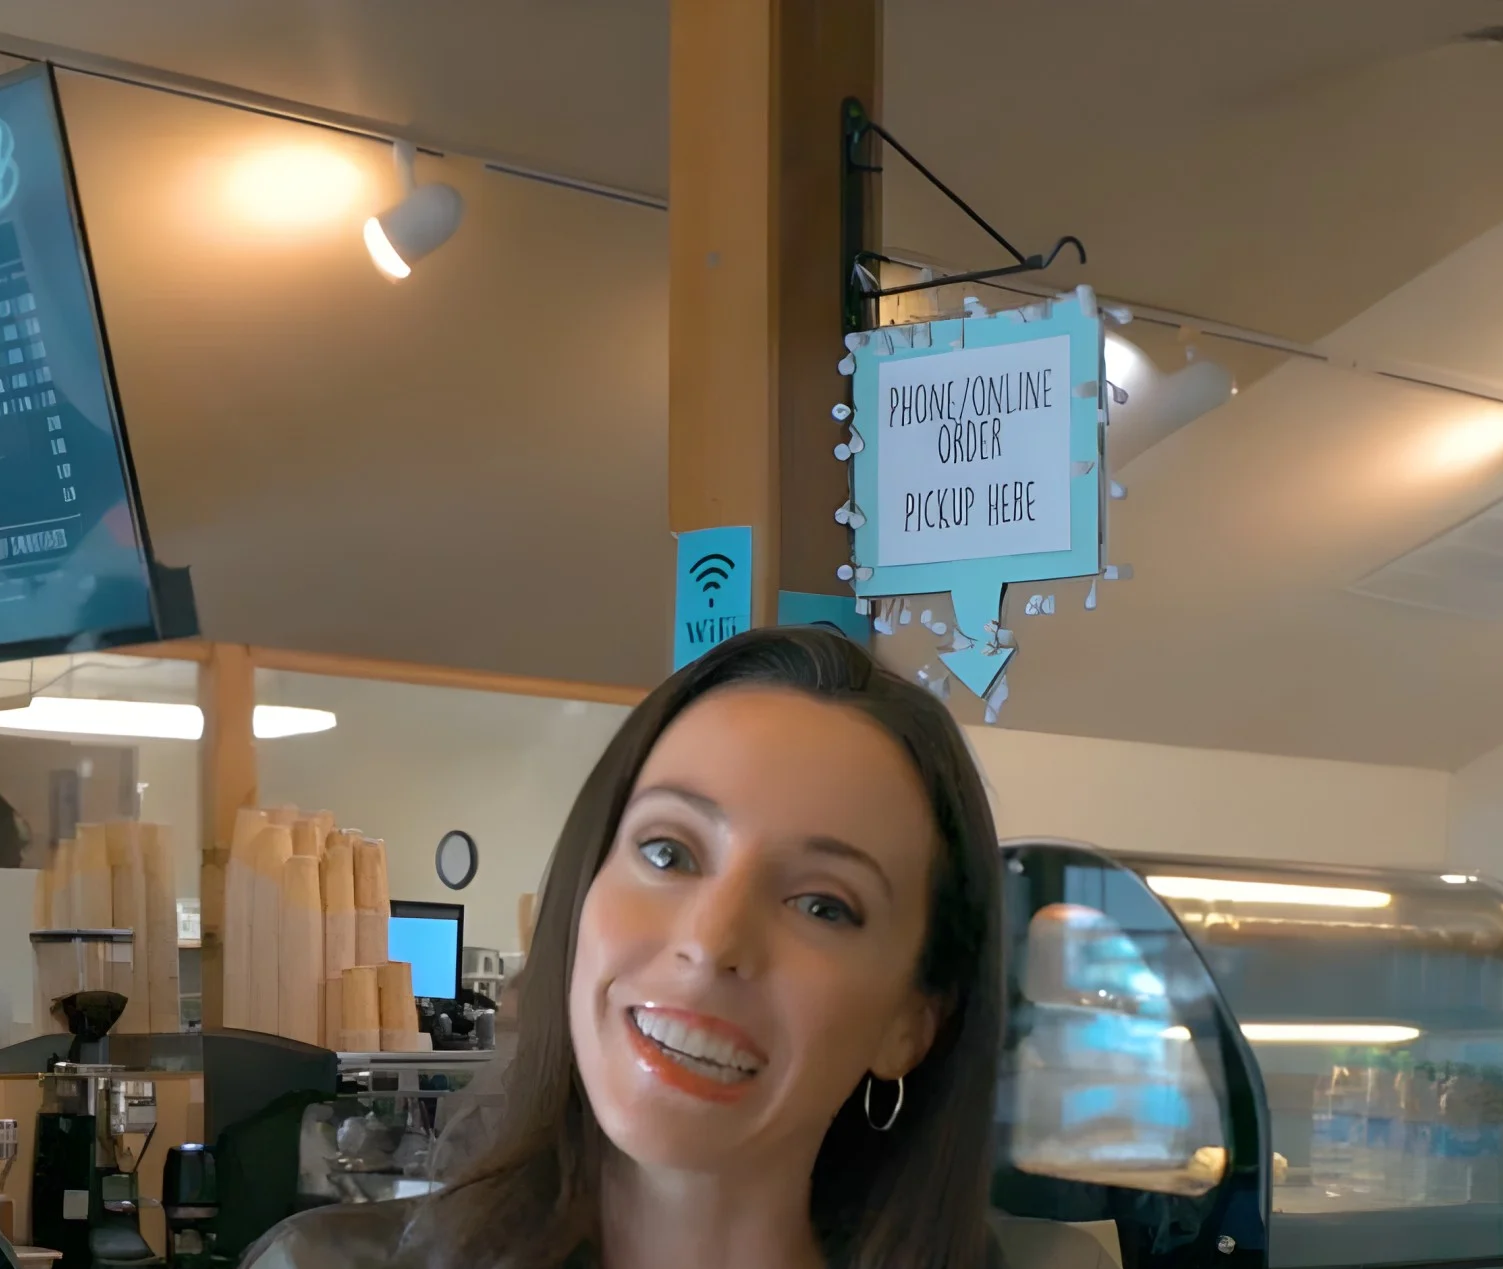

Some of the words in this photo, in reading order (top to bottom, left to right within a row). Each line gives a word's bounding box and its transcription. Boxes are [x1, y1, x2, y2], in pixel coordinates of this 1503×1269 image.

[890, 369, 1052, 427] PHONE/ONLINE
[938, 417, 1002, 464] ORDER
[904, 486, 975, 532] PICKUP
